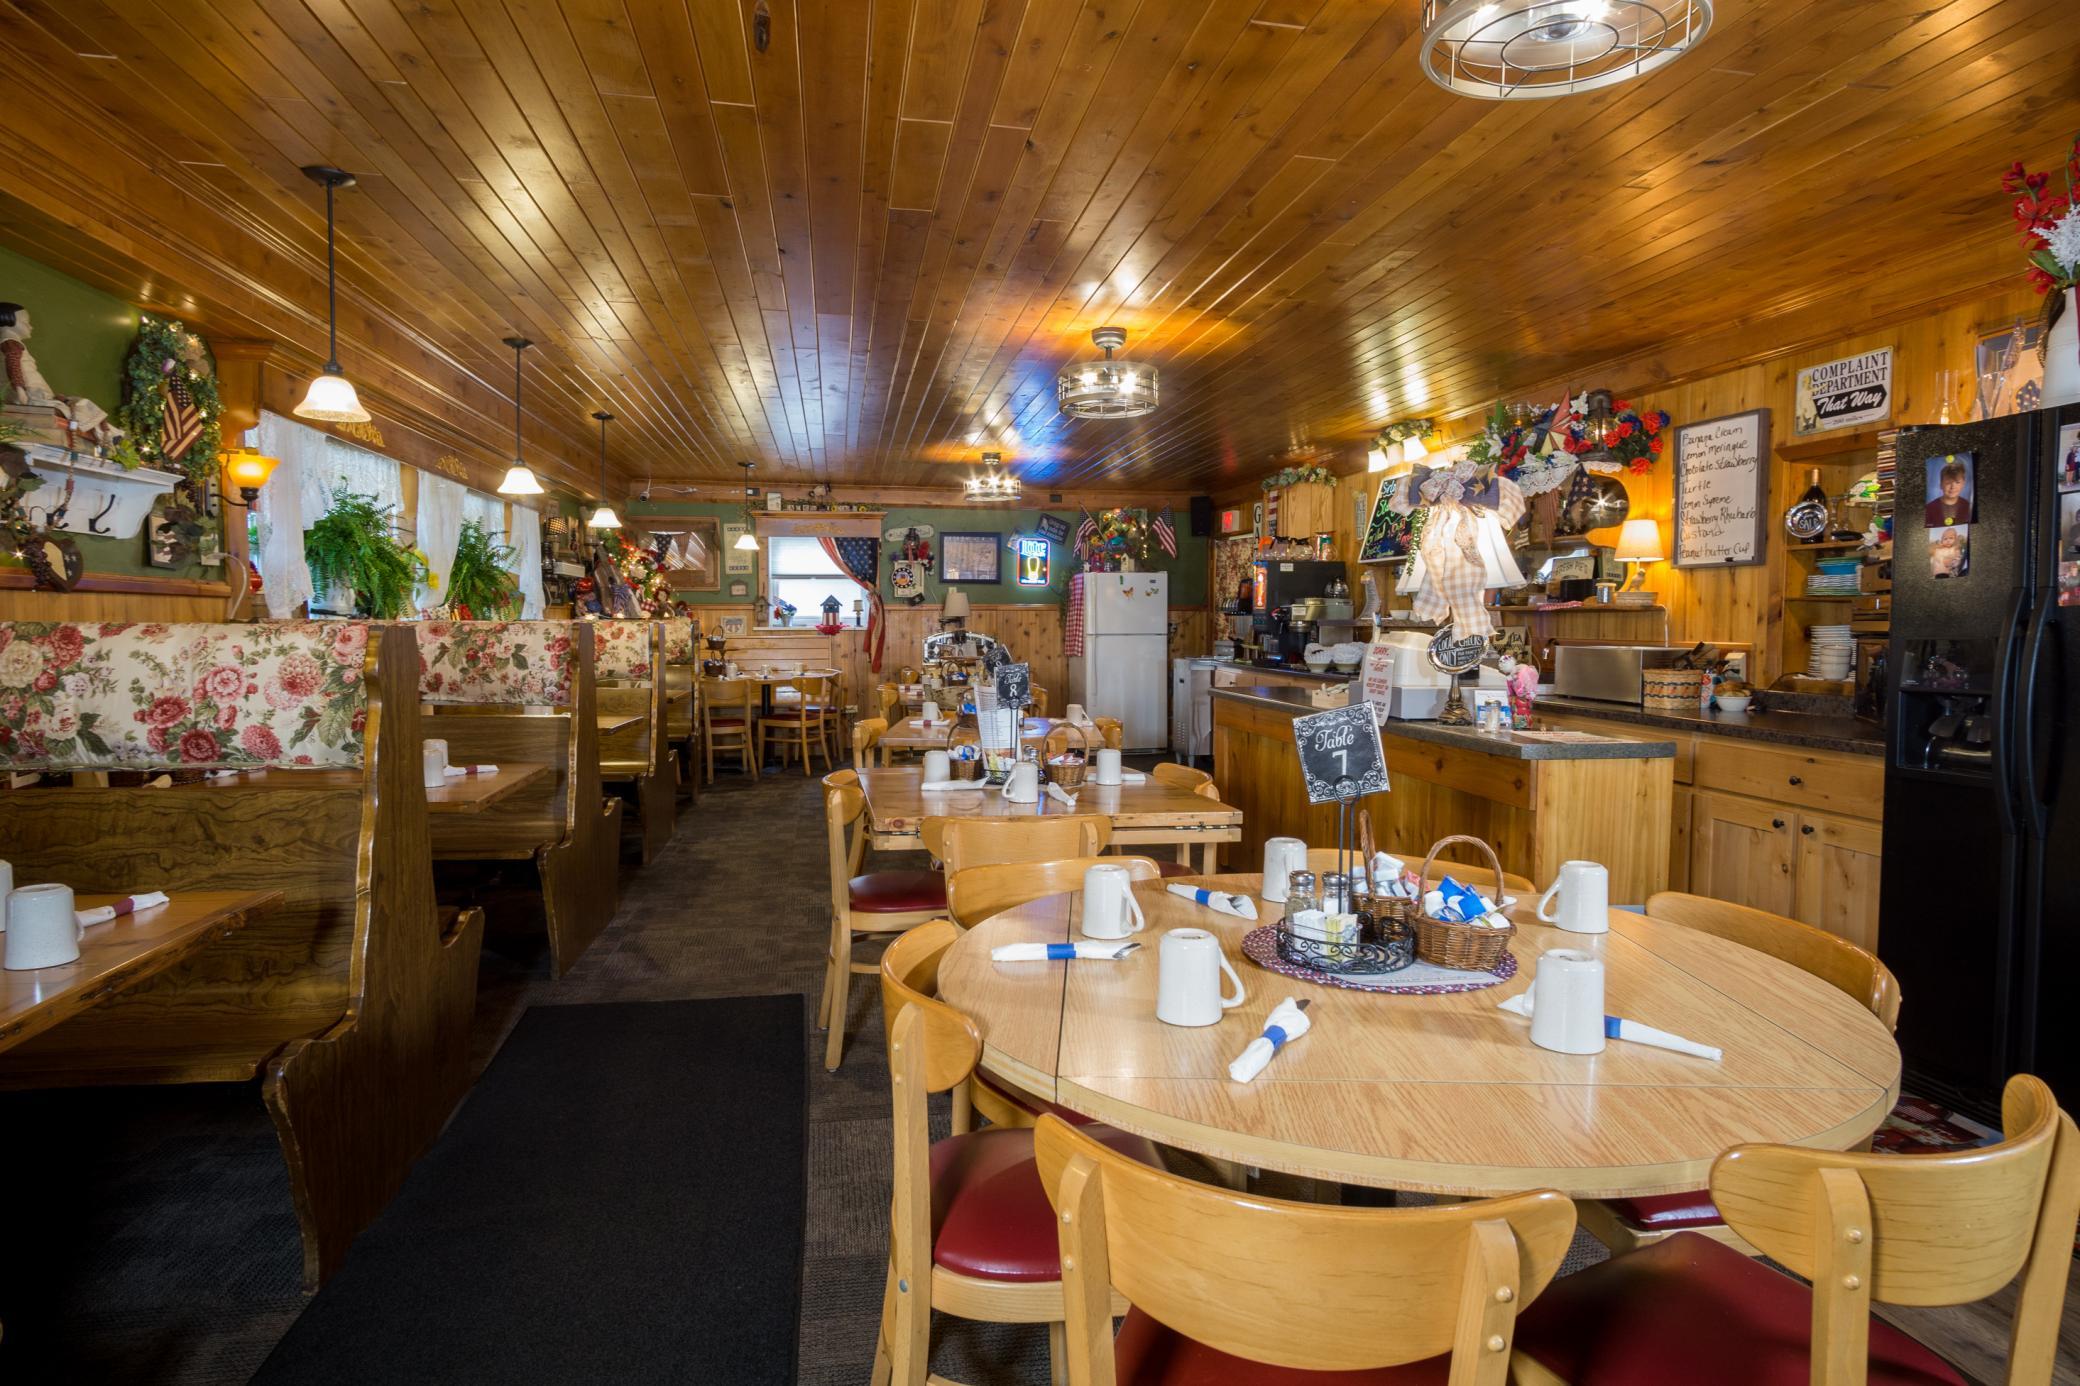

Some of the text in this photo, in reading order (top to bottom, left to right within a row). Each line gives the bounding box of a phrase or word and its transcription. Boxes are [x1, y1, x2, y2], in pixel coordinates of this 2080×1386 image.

[1812, 352, 1888, 382] COMPLAINT
[1812, 367, 1888, 396] DEPARTMENT
[1817, 390, 1882, 414] That Way
[1682, 448, 1706, 461] Lemon
[1680, 480, 1711, 495] Turtle
[1680, 525, 1725, 543] Custard
[1439, 650, 1457, 666] ONLY
[1004, 673, 1021, 685] Table
[1010, 684, 1018, 697] 8
[1315, 725, 1355, 751] Table
[1332, 749, 1348, 776] 7
